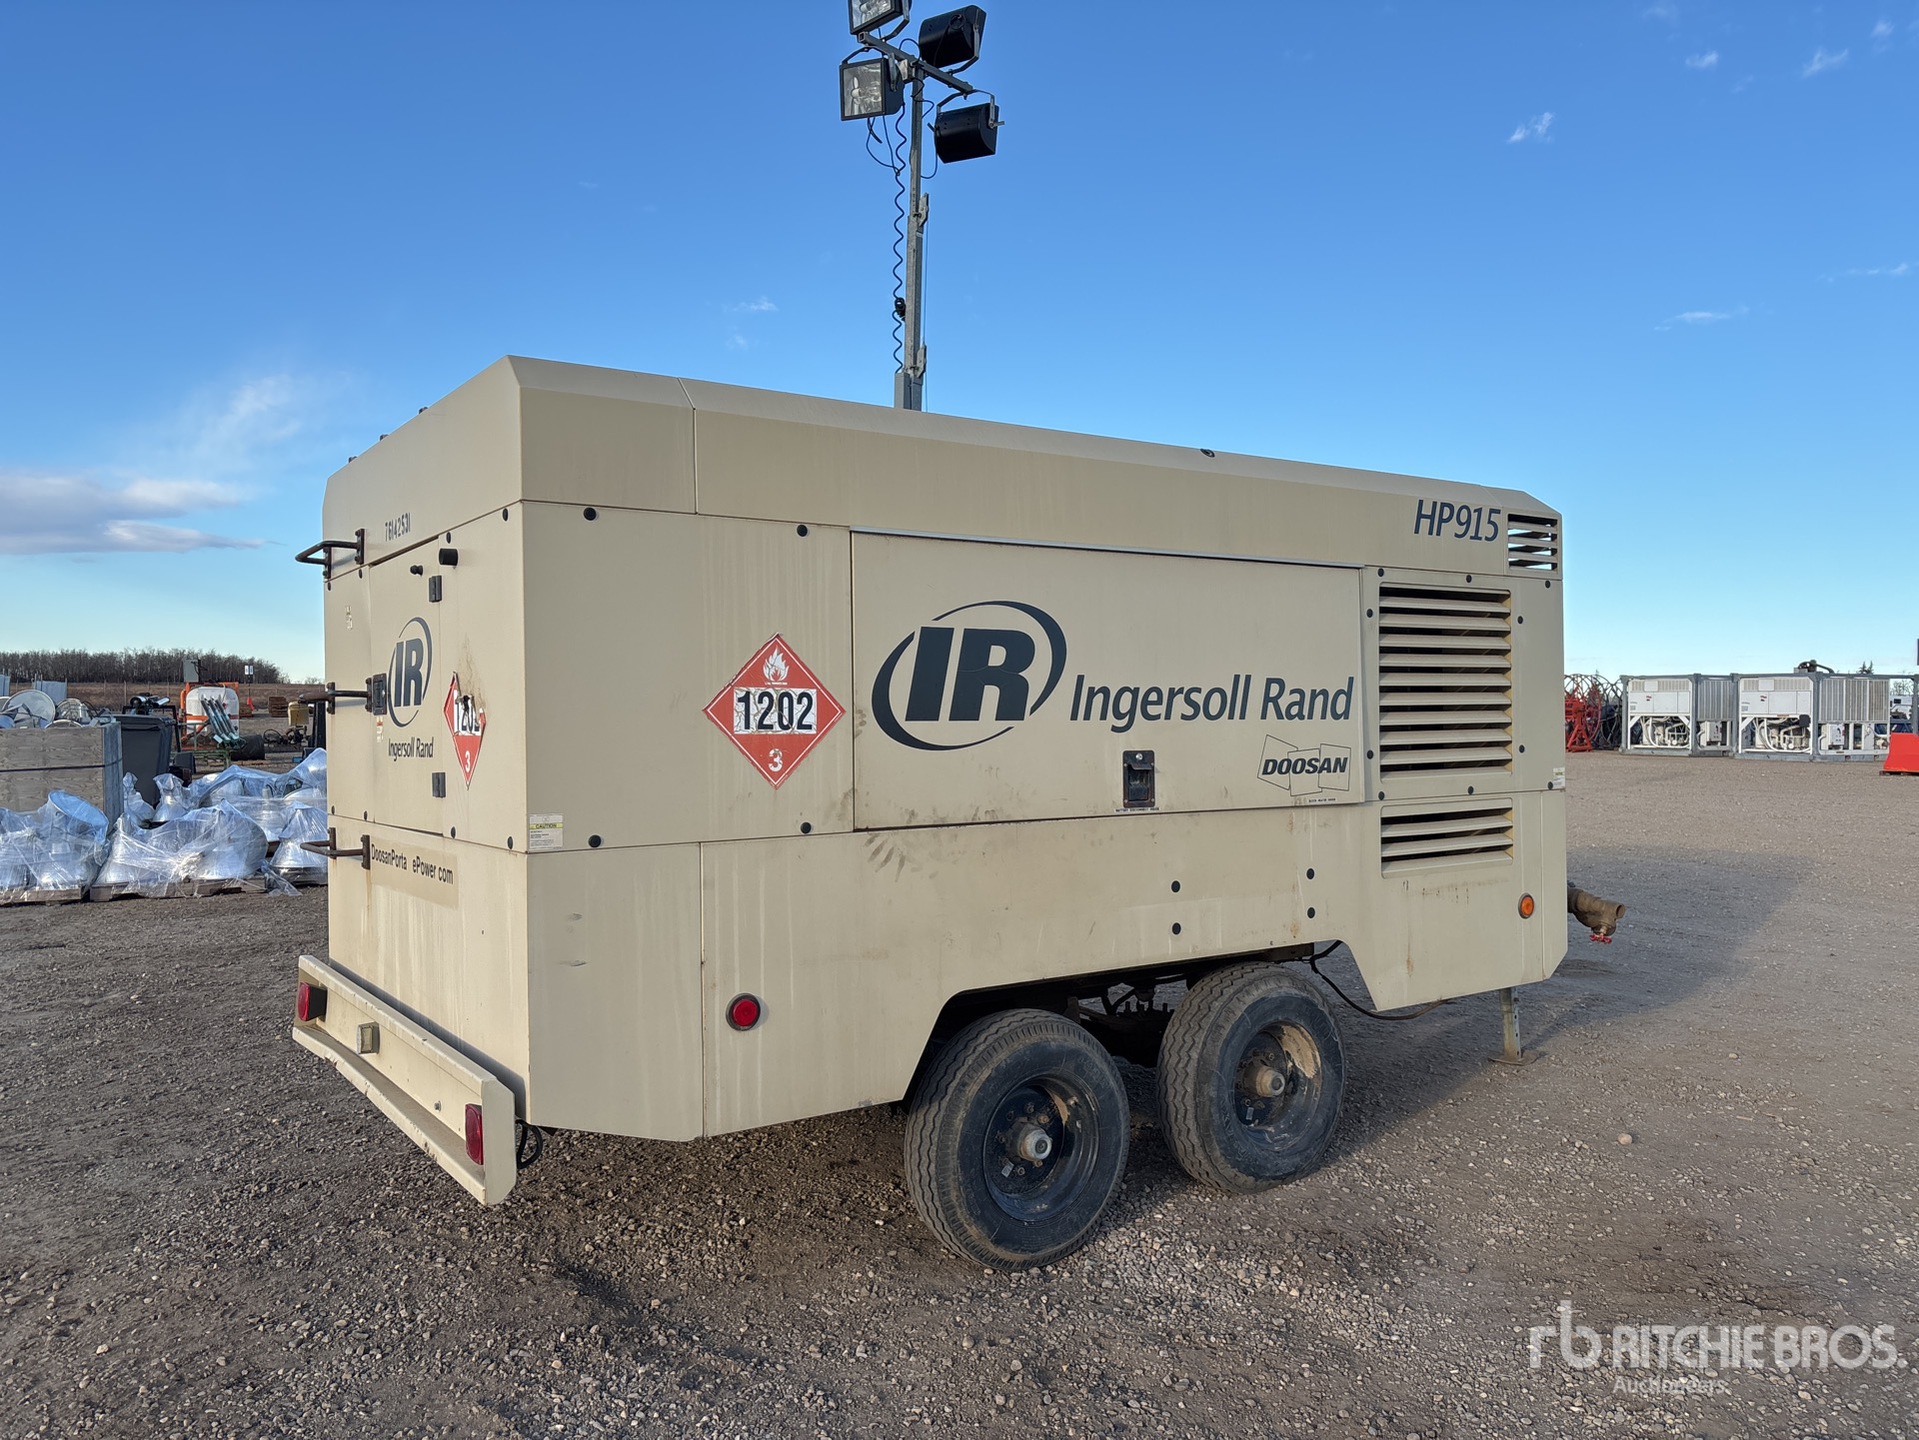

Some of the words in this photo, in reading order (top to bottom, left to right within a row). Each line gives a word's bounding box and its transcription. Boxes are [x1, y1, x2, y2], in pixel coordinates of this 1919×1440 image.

[1413, 499, 1502, 542] HP915
[393, 638, 425, 709] IR
[904, 626, 1036, 722] IR
[737, 690, 813, 731] 1202
[1069, 673, 1252, 734] Ingersoll
[1260, 675, 1355, 721] Rand
[388, 736, 415, 762] Ingersoll
[416, 737, 434, 758] Rand
[464, 750, 471, 773] 3
[768, 748, 783, 773] 3
[1261, 756, 1348, 776] DOOSAN
